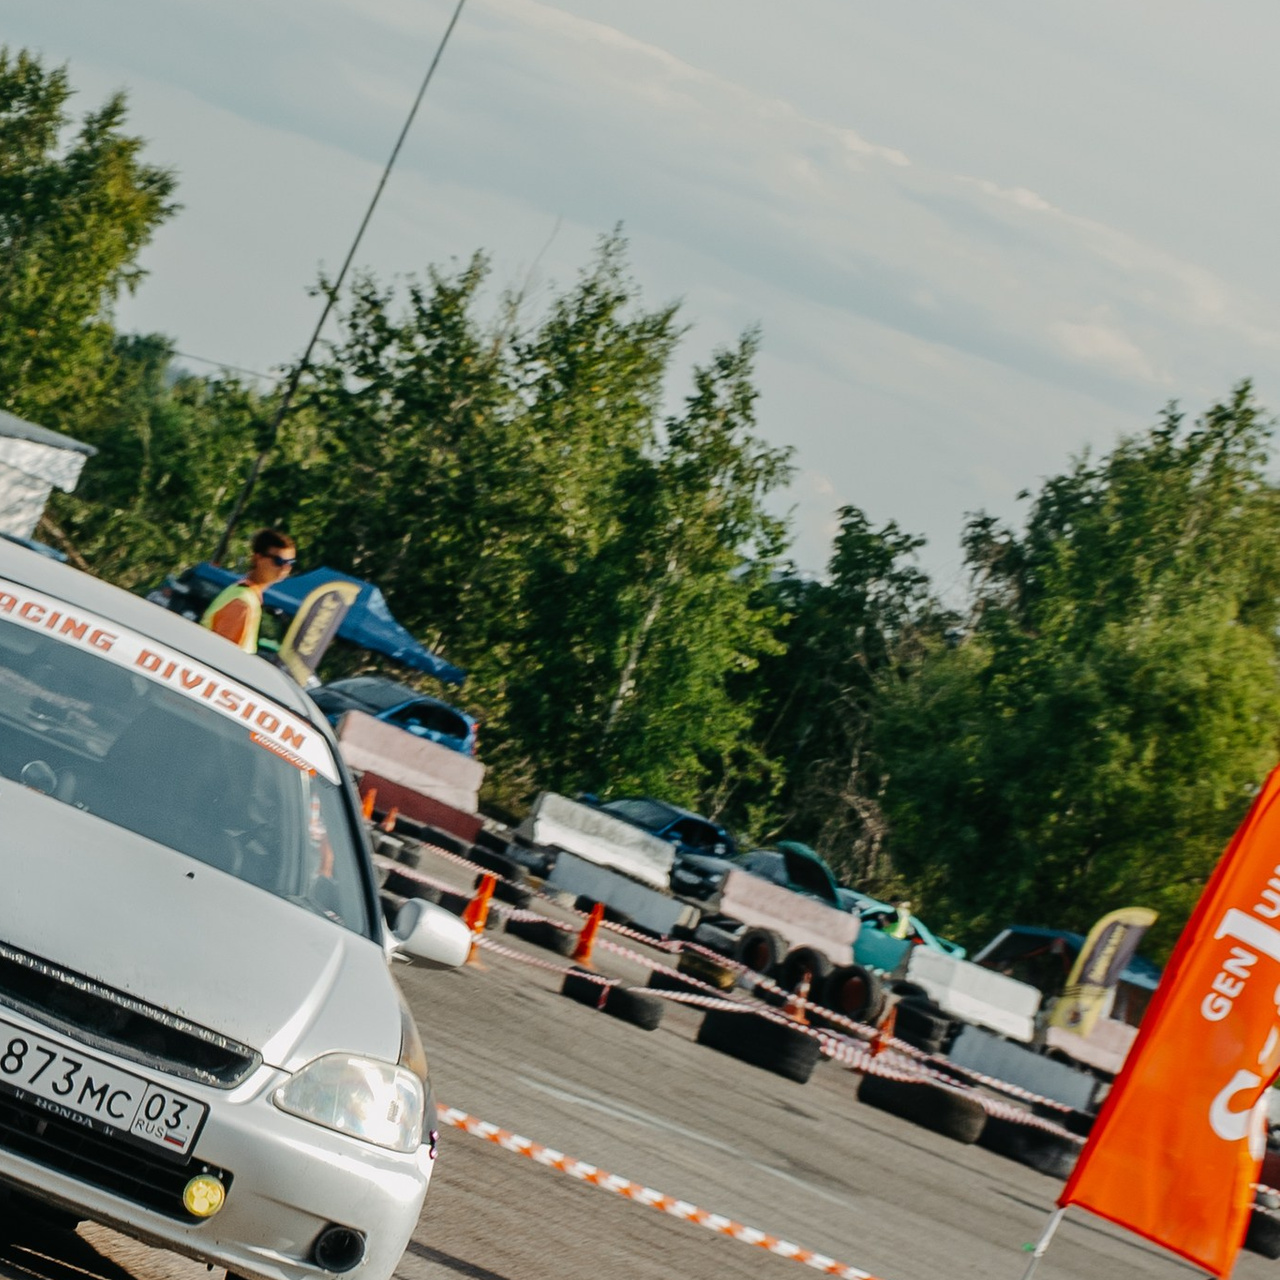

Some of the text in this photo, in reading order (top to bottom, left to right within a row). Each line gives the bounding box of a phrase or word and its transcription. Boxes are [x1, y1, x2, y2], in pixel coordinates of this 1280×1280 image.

[135, 649, 308, 751] DIVISION
[35, 1097, 94, 1130] HONDA
[134, 1119, 166, 1139] RUS
[144, 1093, 189, 1130] 03
